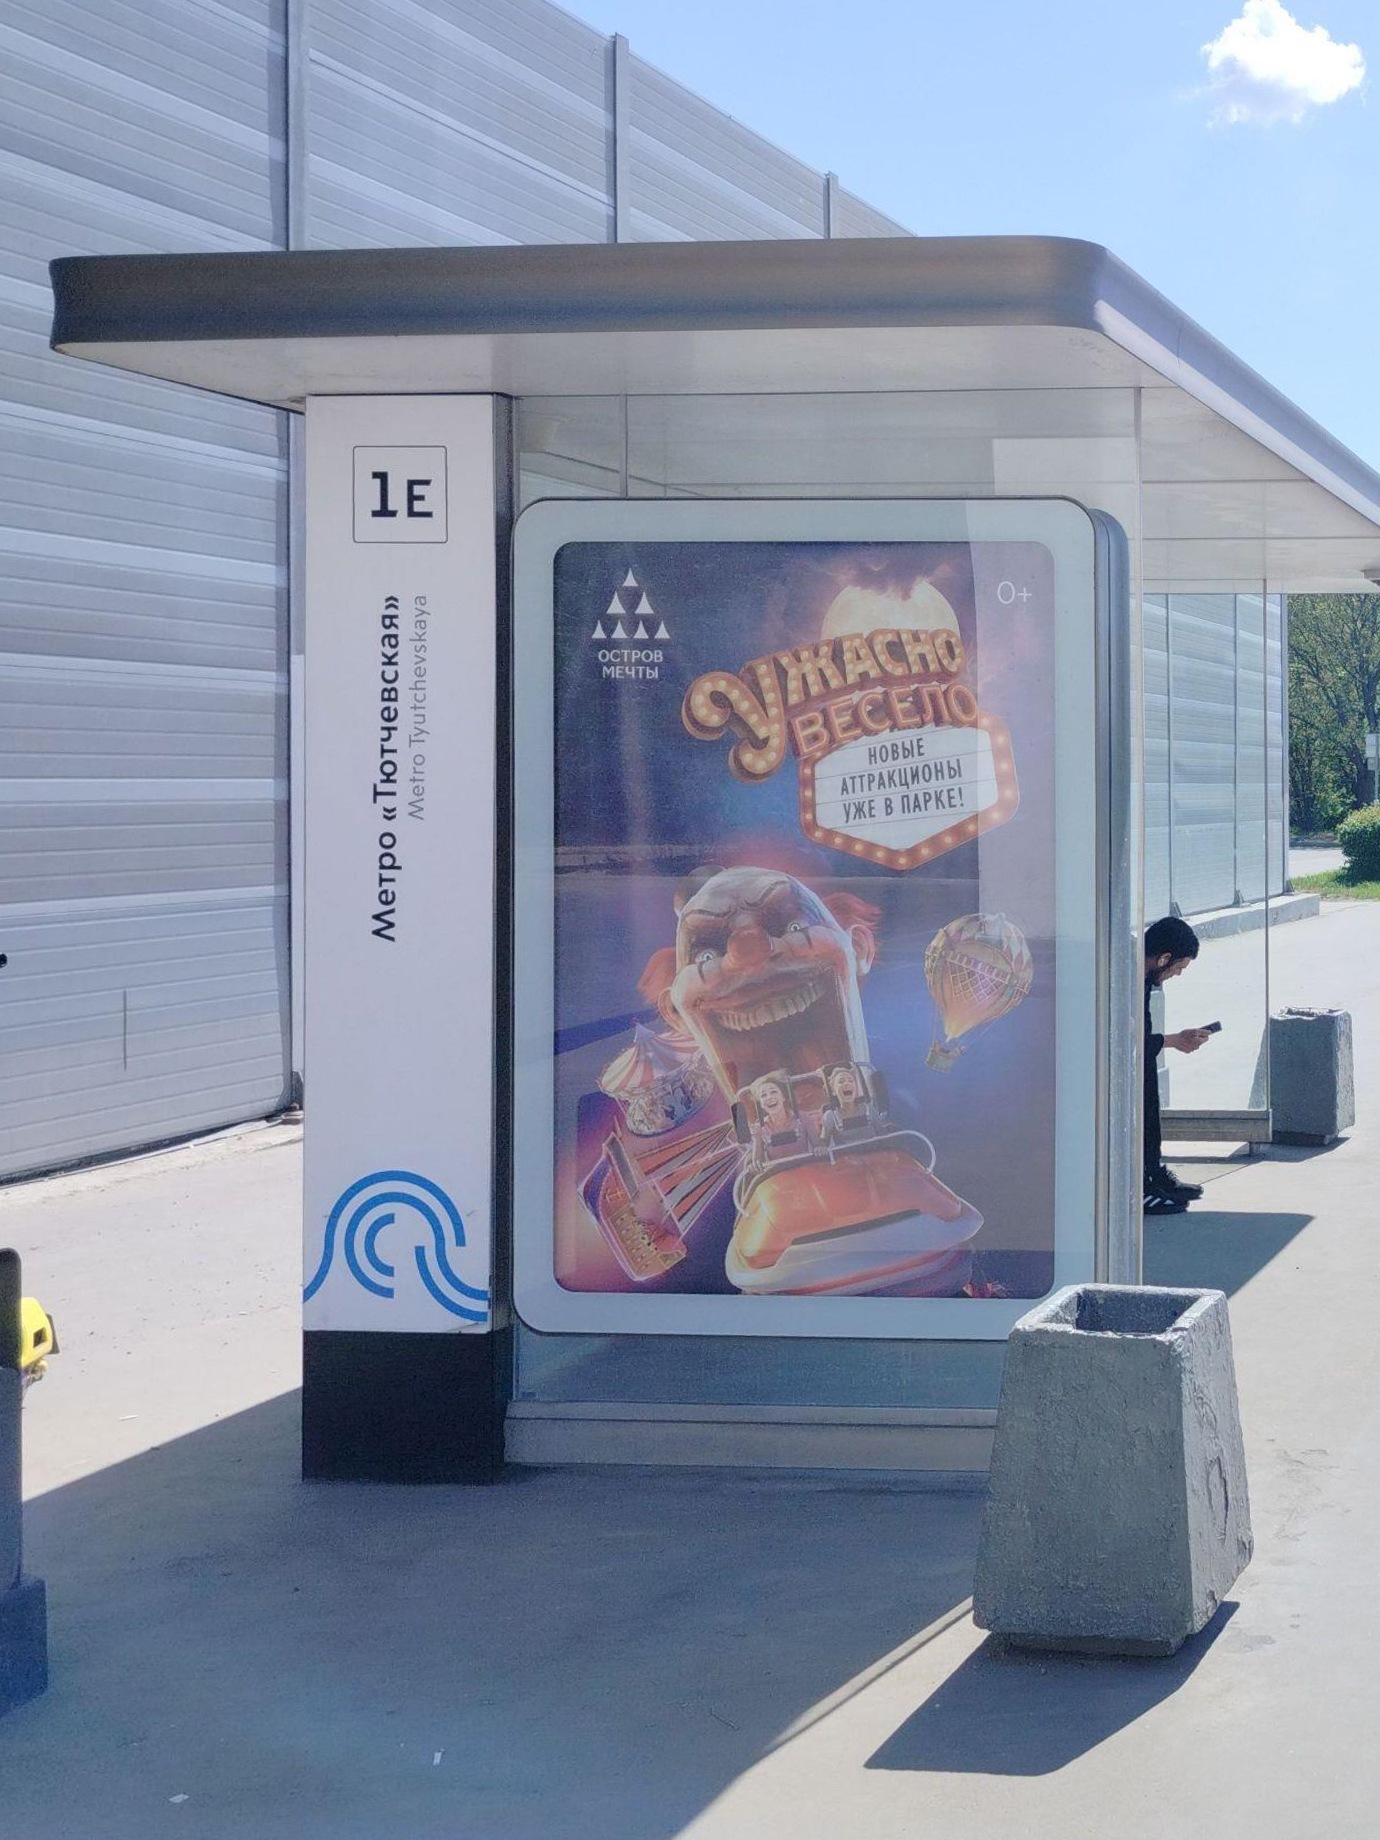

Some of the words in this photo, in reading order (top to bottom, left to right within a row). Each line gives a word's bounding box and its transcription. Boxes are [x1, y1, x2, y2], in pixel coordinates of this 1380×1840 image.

[997, 580, 1033, 605] 0+
[408, 594, 431, 748] Tyutchevskaya
[598, 649, 663, 663] ОСТРОВ
[602, 665, 659, 679] МЕЧТЫ
[373, 595, 400, 821] «Тютчевская»
[682, 628, 967, 782] УЖАСНО
[789, 682, 979, 756] ВЕСЕЛО
[841, 759, 963, 796] АТТРАКЦИОНЫ
[868, 738, 925, 765] НОВЫЕ
[408, 753, 427, 821] Metro
[843, 799, 876, 824] УЖЕ
[885, 797, 894, 816] В
[901, 787, 964, 815] ПАРКЕ!
[371, 831, 402, 943] Метро
